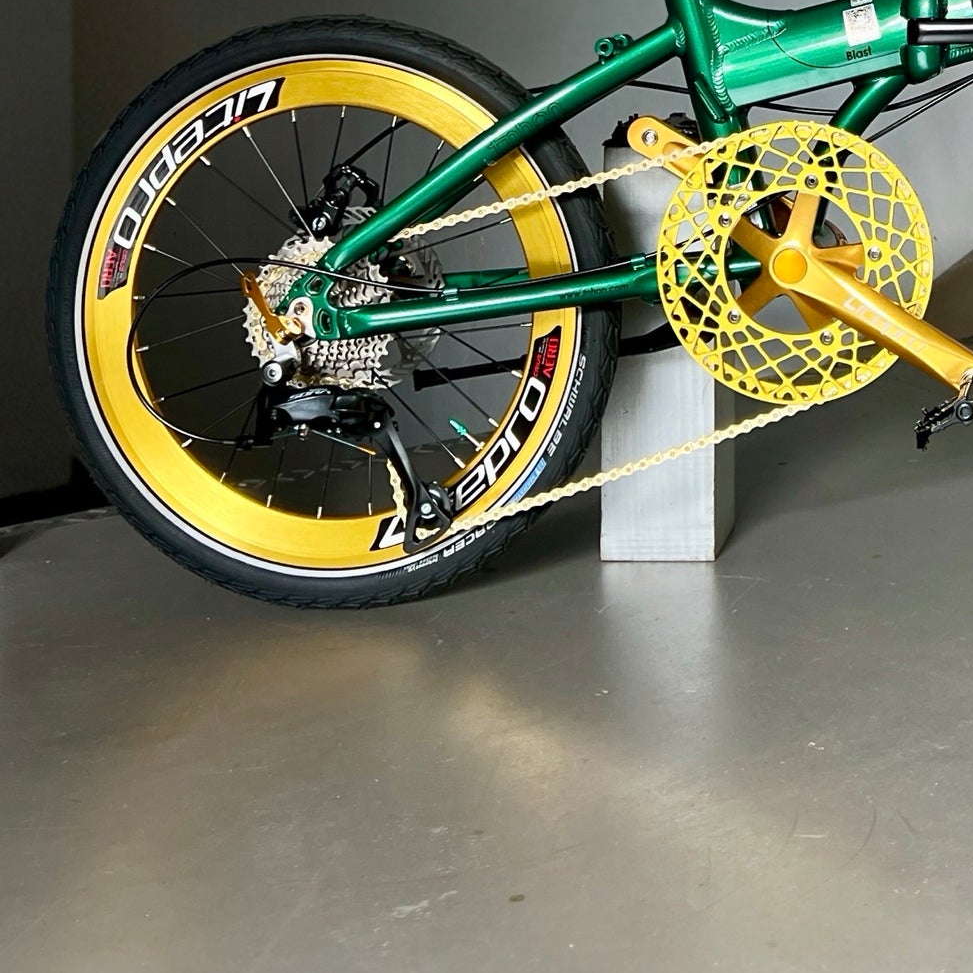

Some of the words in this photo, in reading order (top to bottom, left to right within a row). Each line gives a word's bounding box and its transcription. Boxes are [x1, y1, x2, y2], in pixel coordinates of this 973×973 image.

[846, 45, 873, 61] Blast
[543, 337, 560, 379] AERO
[547, 353, 587, 457] SCHWALBE
